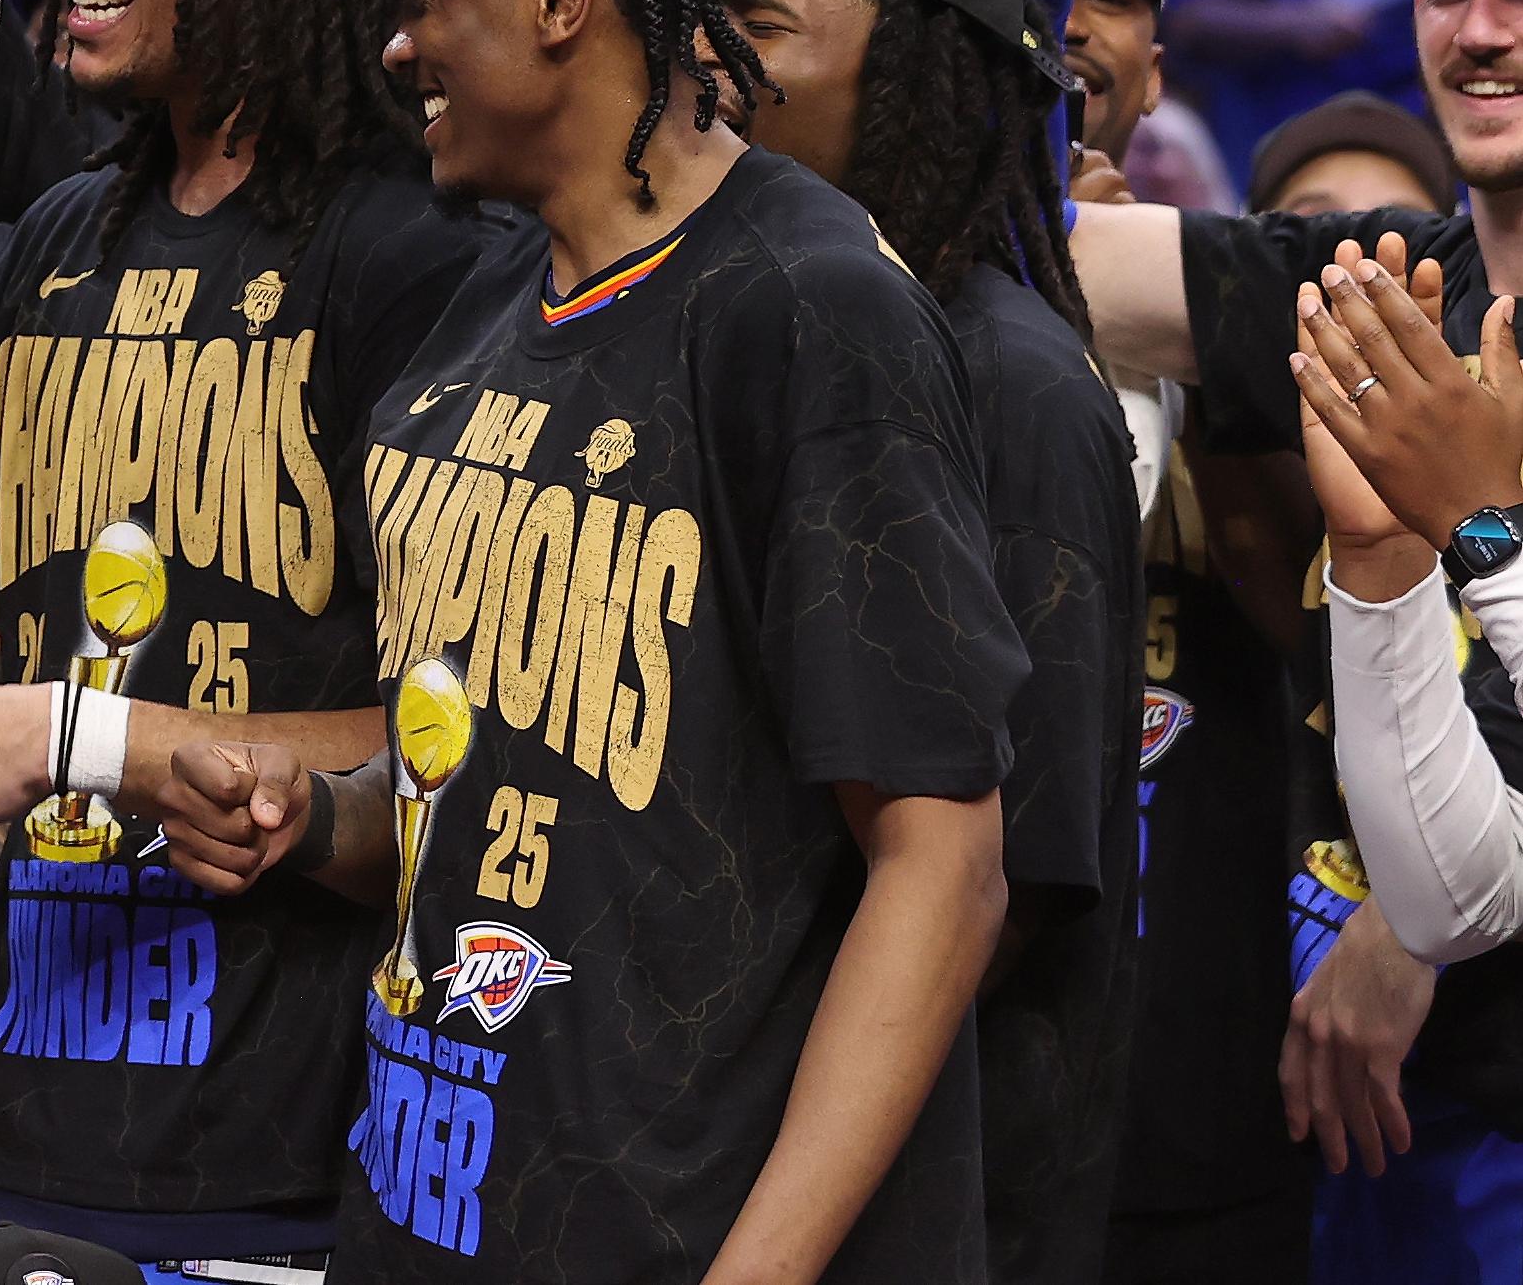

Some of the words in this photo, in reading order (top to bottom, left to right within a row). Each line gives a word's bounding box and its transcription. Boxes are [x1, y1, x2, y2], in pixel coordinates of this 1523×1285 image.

[104, 268, 200, 335] NBA
[452, 388, 552, 472] NBA
[187, 619, 250, 715] 25
[476, 785, 559, 909] 25
[455, 947, 528, 994] OKC
[434, 1034, 508, 1085] CITY
